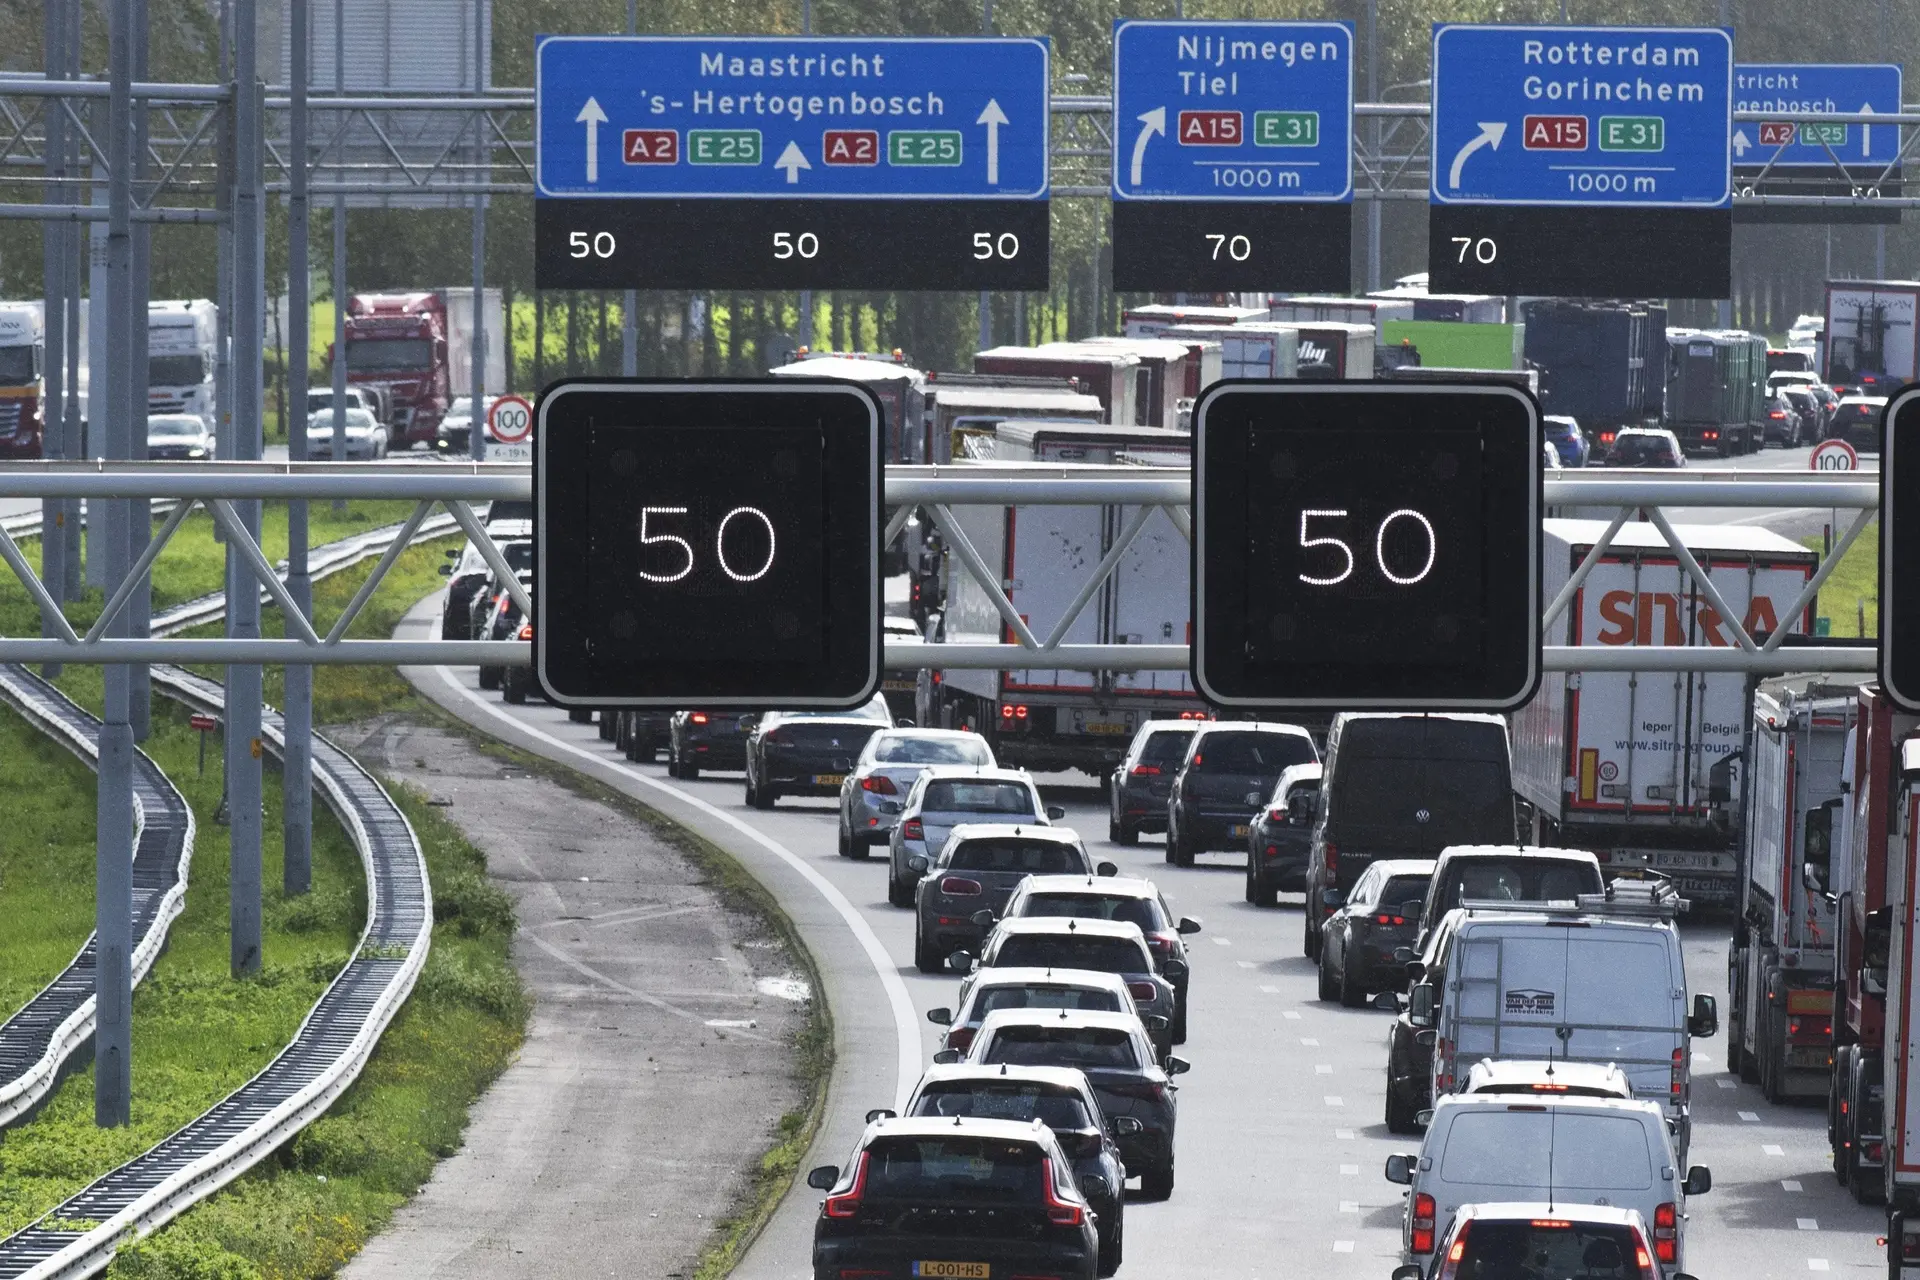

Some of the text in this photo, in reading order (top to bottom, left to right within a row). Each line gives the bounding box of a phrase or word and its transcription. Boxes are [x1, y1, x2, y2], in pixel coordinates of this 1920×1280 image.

[1178, 35, 1337, 68] Nijmegen
[1524, 40, 1699, 66] Rotterdam
[700, 52, 884, 77] Maastricht
[1178, 71, 1237, 96] Tiel
[1523, 75, 1704, 102] Gorinchem
[1737, 74, 1799, 89] tricht
[1734, 97, 1836, 113] genbosch
[1185, 117, 1236, 140] A15
[1531, 122, 1582, 144] A15
[1213, 168, 1300, 188] 1000 m
[1568, 173, 1656, 193] 1000 m
[569, 231, 616, 259] 50
[773, 232, 819, 259] 50
[973, 232, 1019, 260] 50
[1205, 234, 1251, 261] 70
[1451, 236, 1497, 264] 70
[496, 410, 527, 429] 100
[1818, 454, 1849, 471] 100
[639, 506, 776, 583] 50
[1299, 508, 1436, 586] 50
[1642, 721, 1740, 737] Ieper België
[1614, 739, 1743, 755] www.sitra-group.c
[911, 1207, 996, 1216] VOLVO
[924, 1263, 984, 1277] L-001-HS
